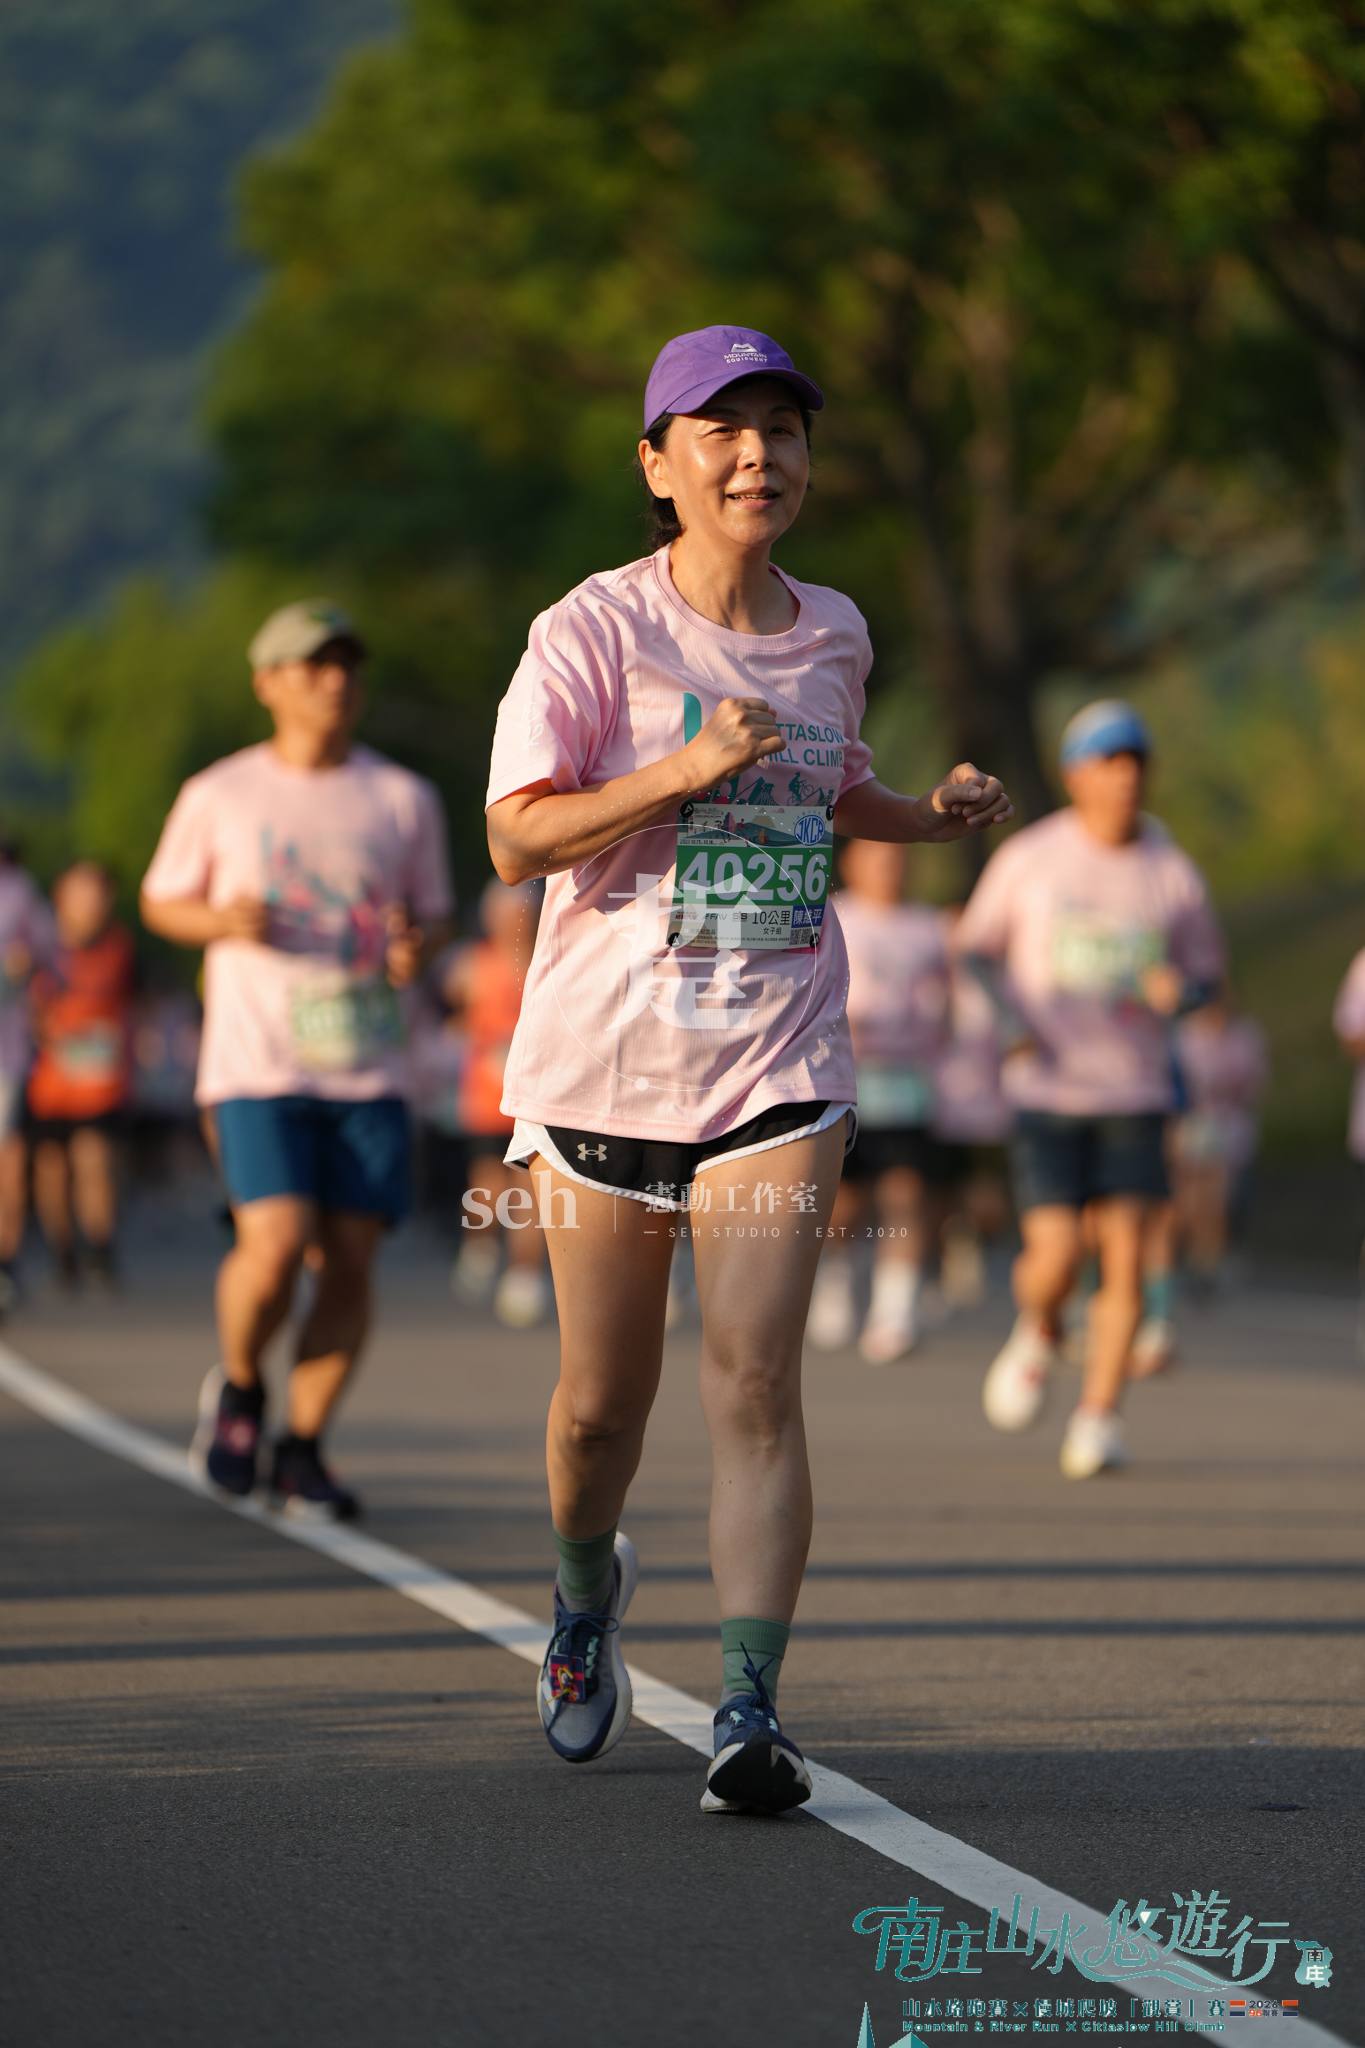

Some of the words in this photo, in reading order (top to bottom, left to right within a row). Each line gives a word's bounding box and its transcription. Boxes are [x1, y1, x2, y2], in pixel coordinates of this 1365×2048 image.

[723, 352, 768, 360] MOUNTAIN
[726, 356, 768, 364] EQUIPMENT
[769, 748, 799, 765] ILL
[679, 851, 828, 902] 40256
[752, 910, 790, 926] 10公里
